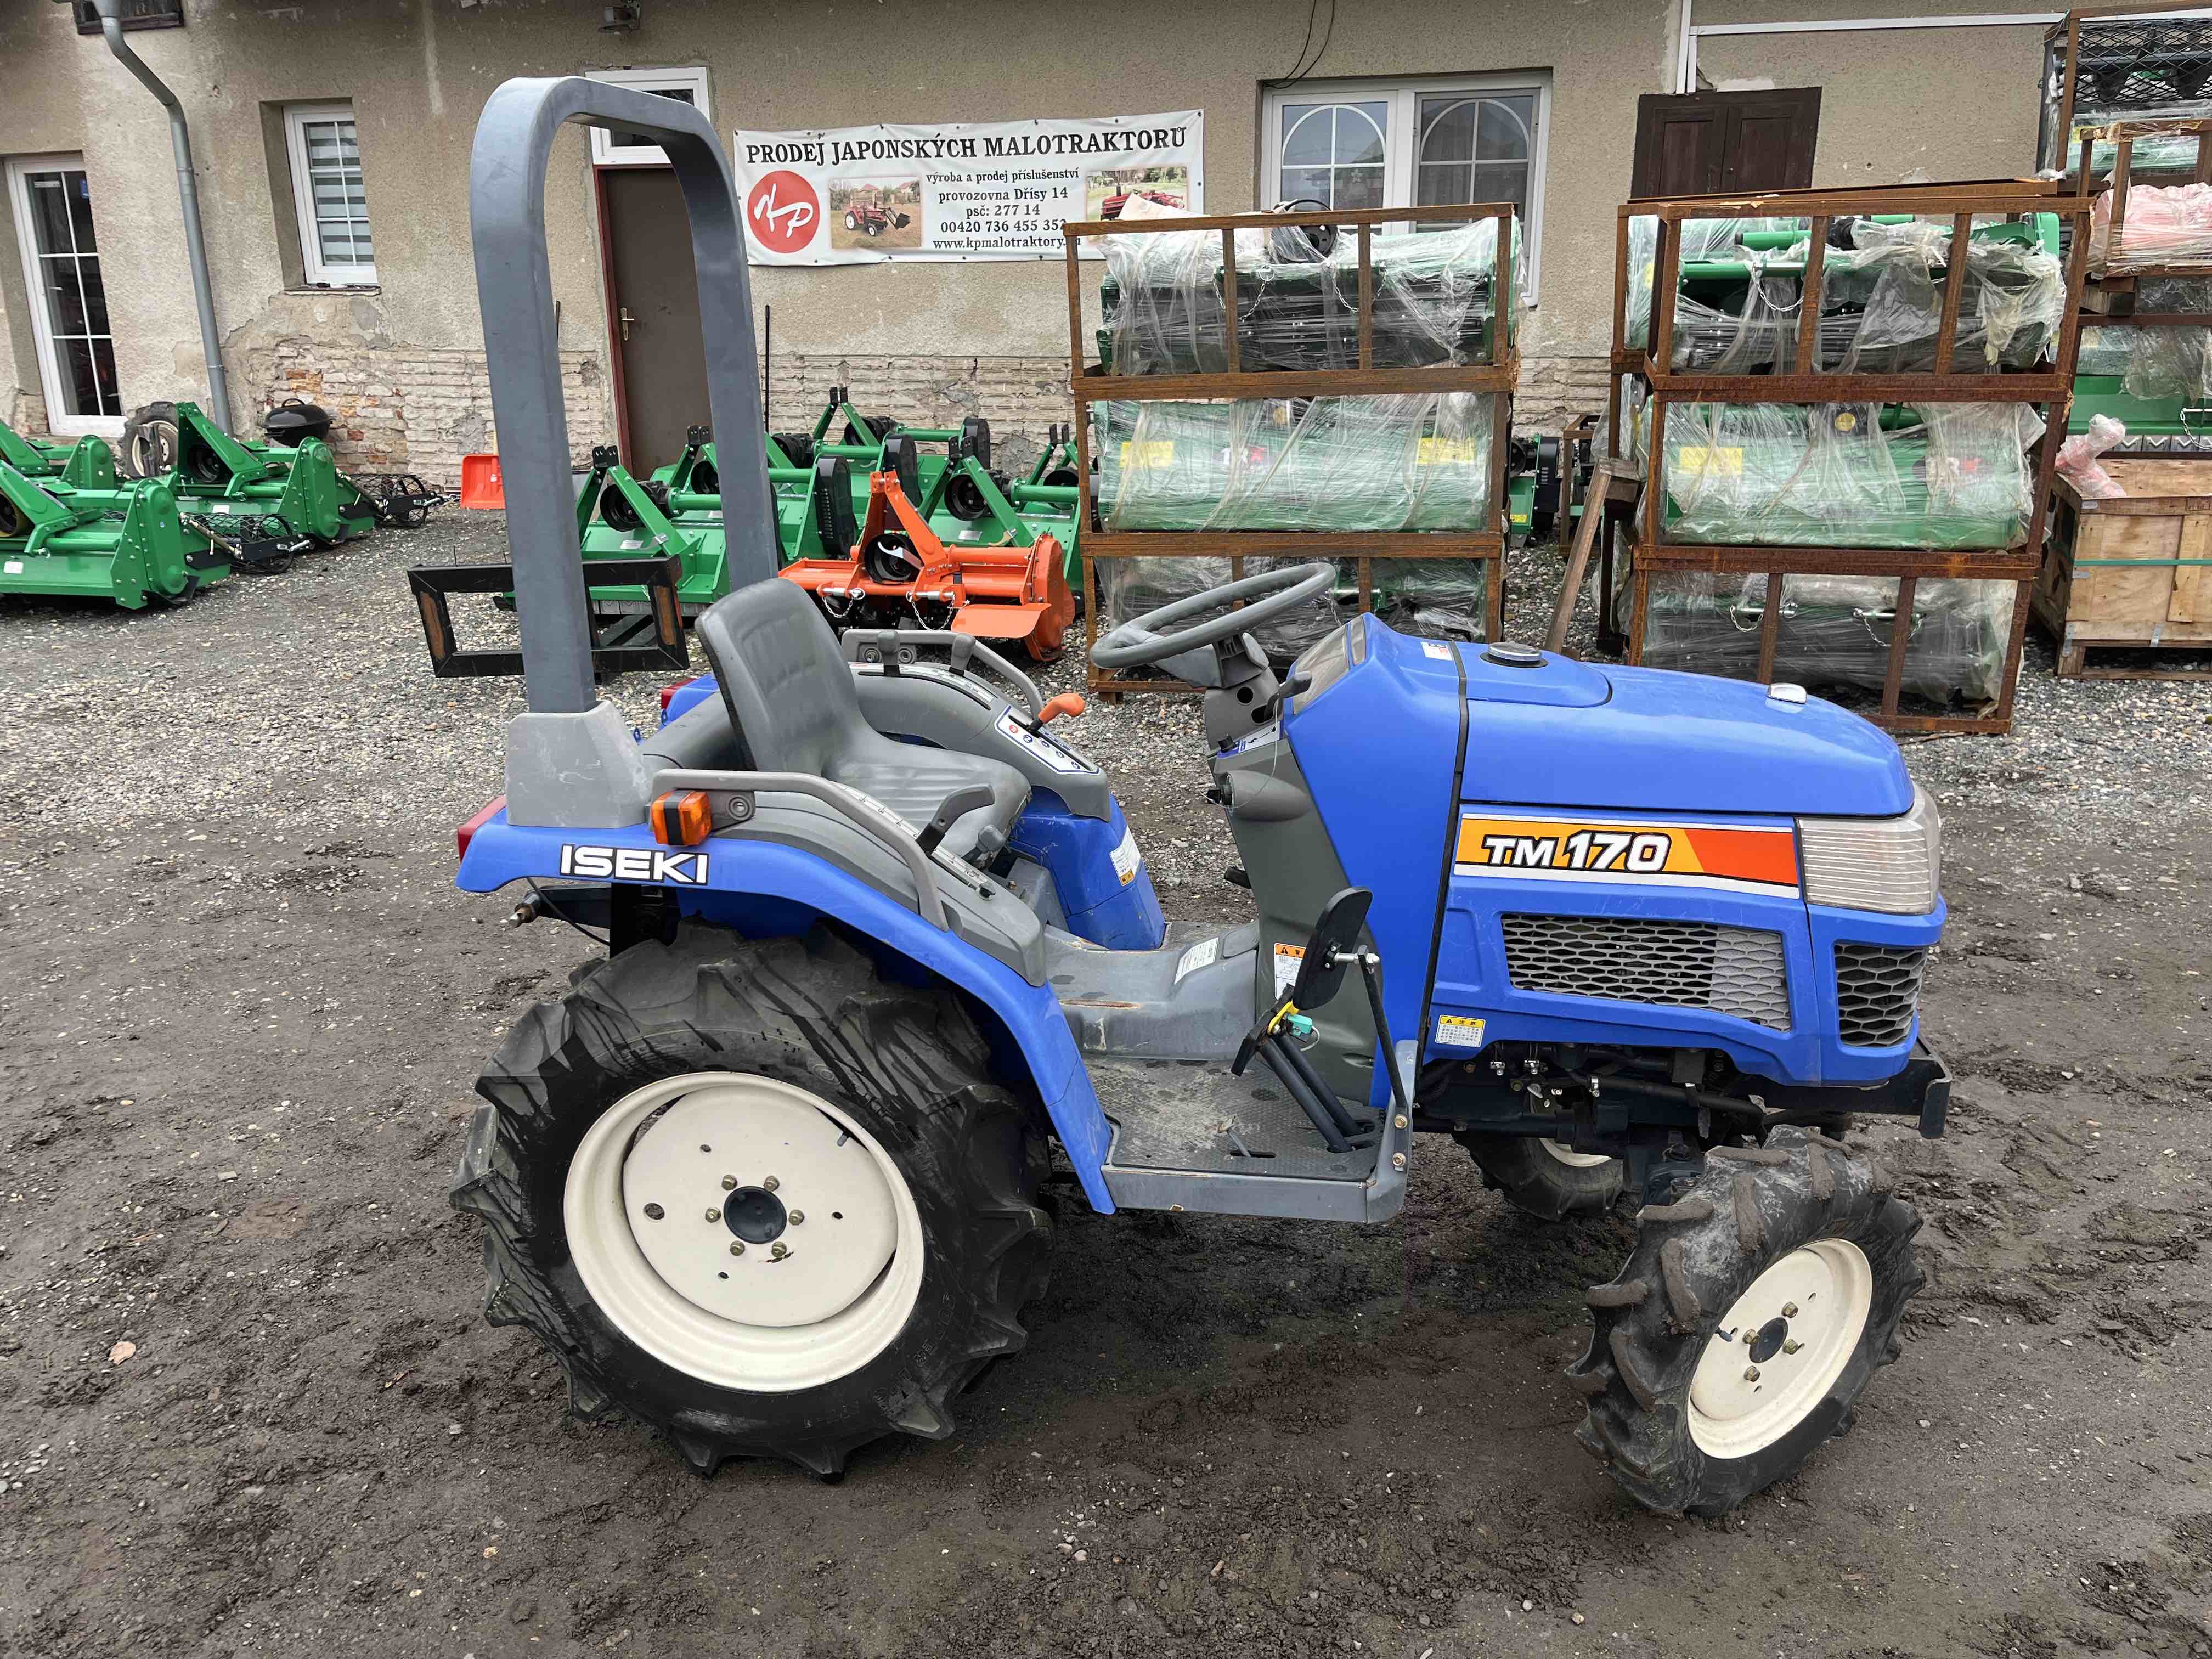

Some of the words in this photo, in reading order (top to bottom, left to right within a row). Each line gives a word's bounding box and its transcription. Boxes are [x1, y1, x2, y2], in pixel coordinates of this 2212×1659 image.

[747, 143, 825, 166] PRODEJ
[832, 133, 977, 166] JAPONSKÝCH
[983, 127, 1187, 157] MALOTRAKTORŮ
[927, 171, 962, 184] výroba
[976, 171, 1008, 184] prodej
[1012, 167, 1079, 183] příslušenství
[939, 190, 1009, 204] provozovna
[1014, 188, 1047, 202] Dřísy
[1052, 187, 1068, 199] 14
[966, 206, 990, 219] psč:
[994, 205, 1020, 216] 277
[1024, 204, 1040, 216] 14
[941, 221, 981, 233] 00420
[986, 221, 1009, 232] 736
[1014, 219, 1038, 232] 455
[560, 844, 709, 885] ISEKI
